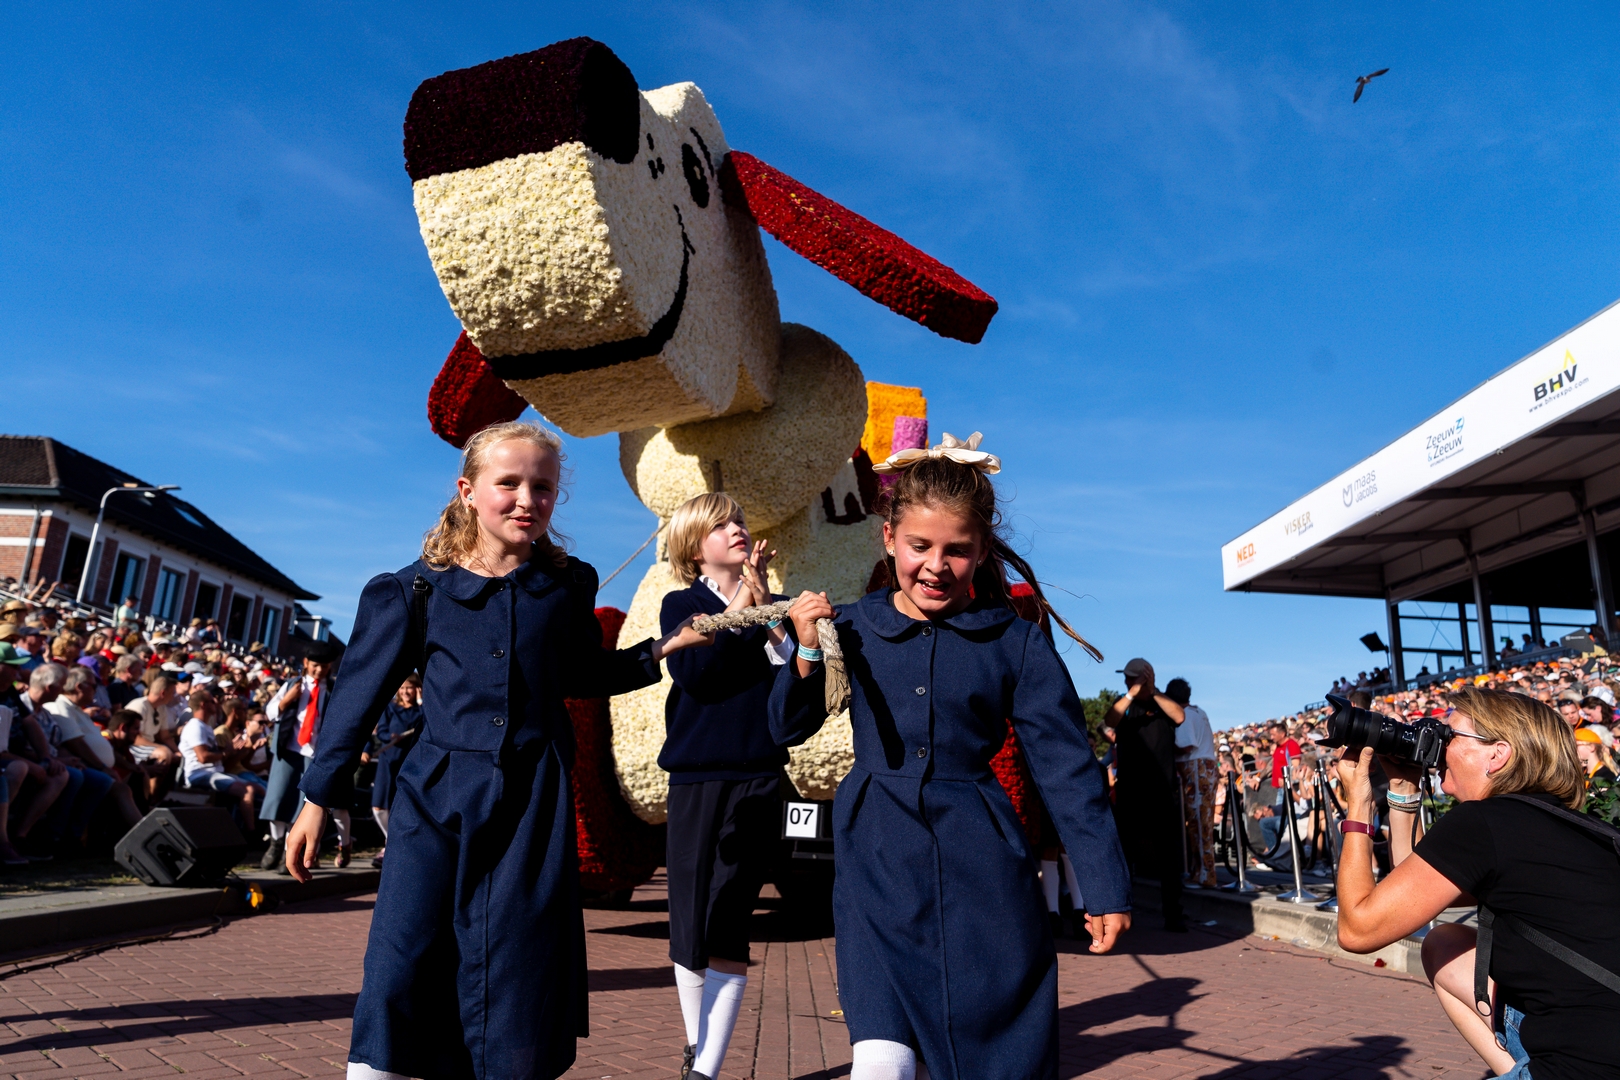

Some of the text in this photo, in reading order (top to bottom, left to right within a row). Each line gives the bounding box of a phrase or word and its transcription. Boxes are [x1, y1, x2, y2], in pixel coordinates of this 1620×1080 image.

[1529, 377, 1589, 413] www.bhvexpo.com
[1534, 364, 1577, 402] BHV
[1426, 425, 1455, 450] Zeeuw
[1433, 435, 1463, 459] Zeeuw
[1354, 470, 1376, 491] maas
[1284, 511, 1311, 536] VISKER
[789, 807, 814, 825] 07
